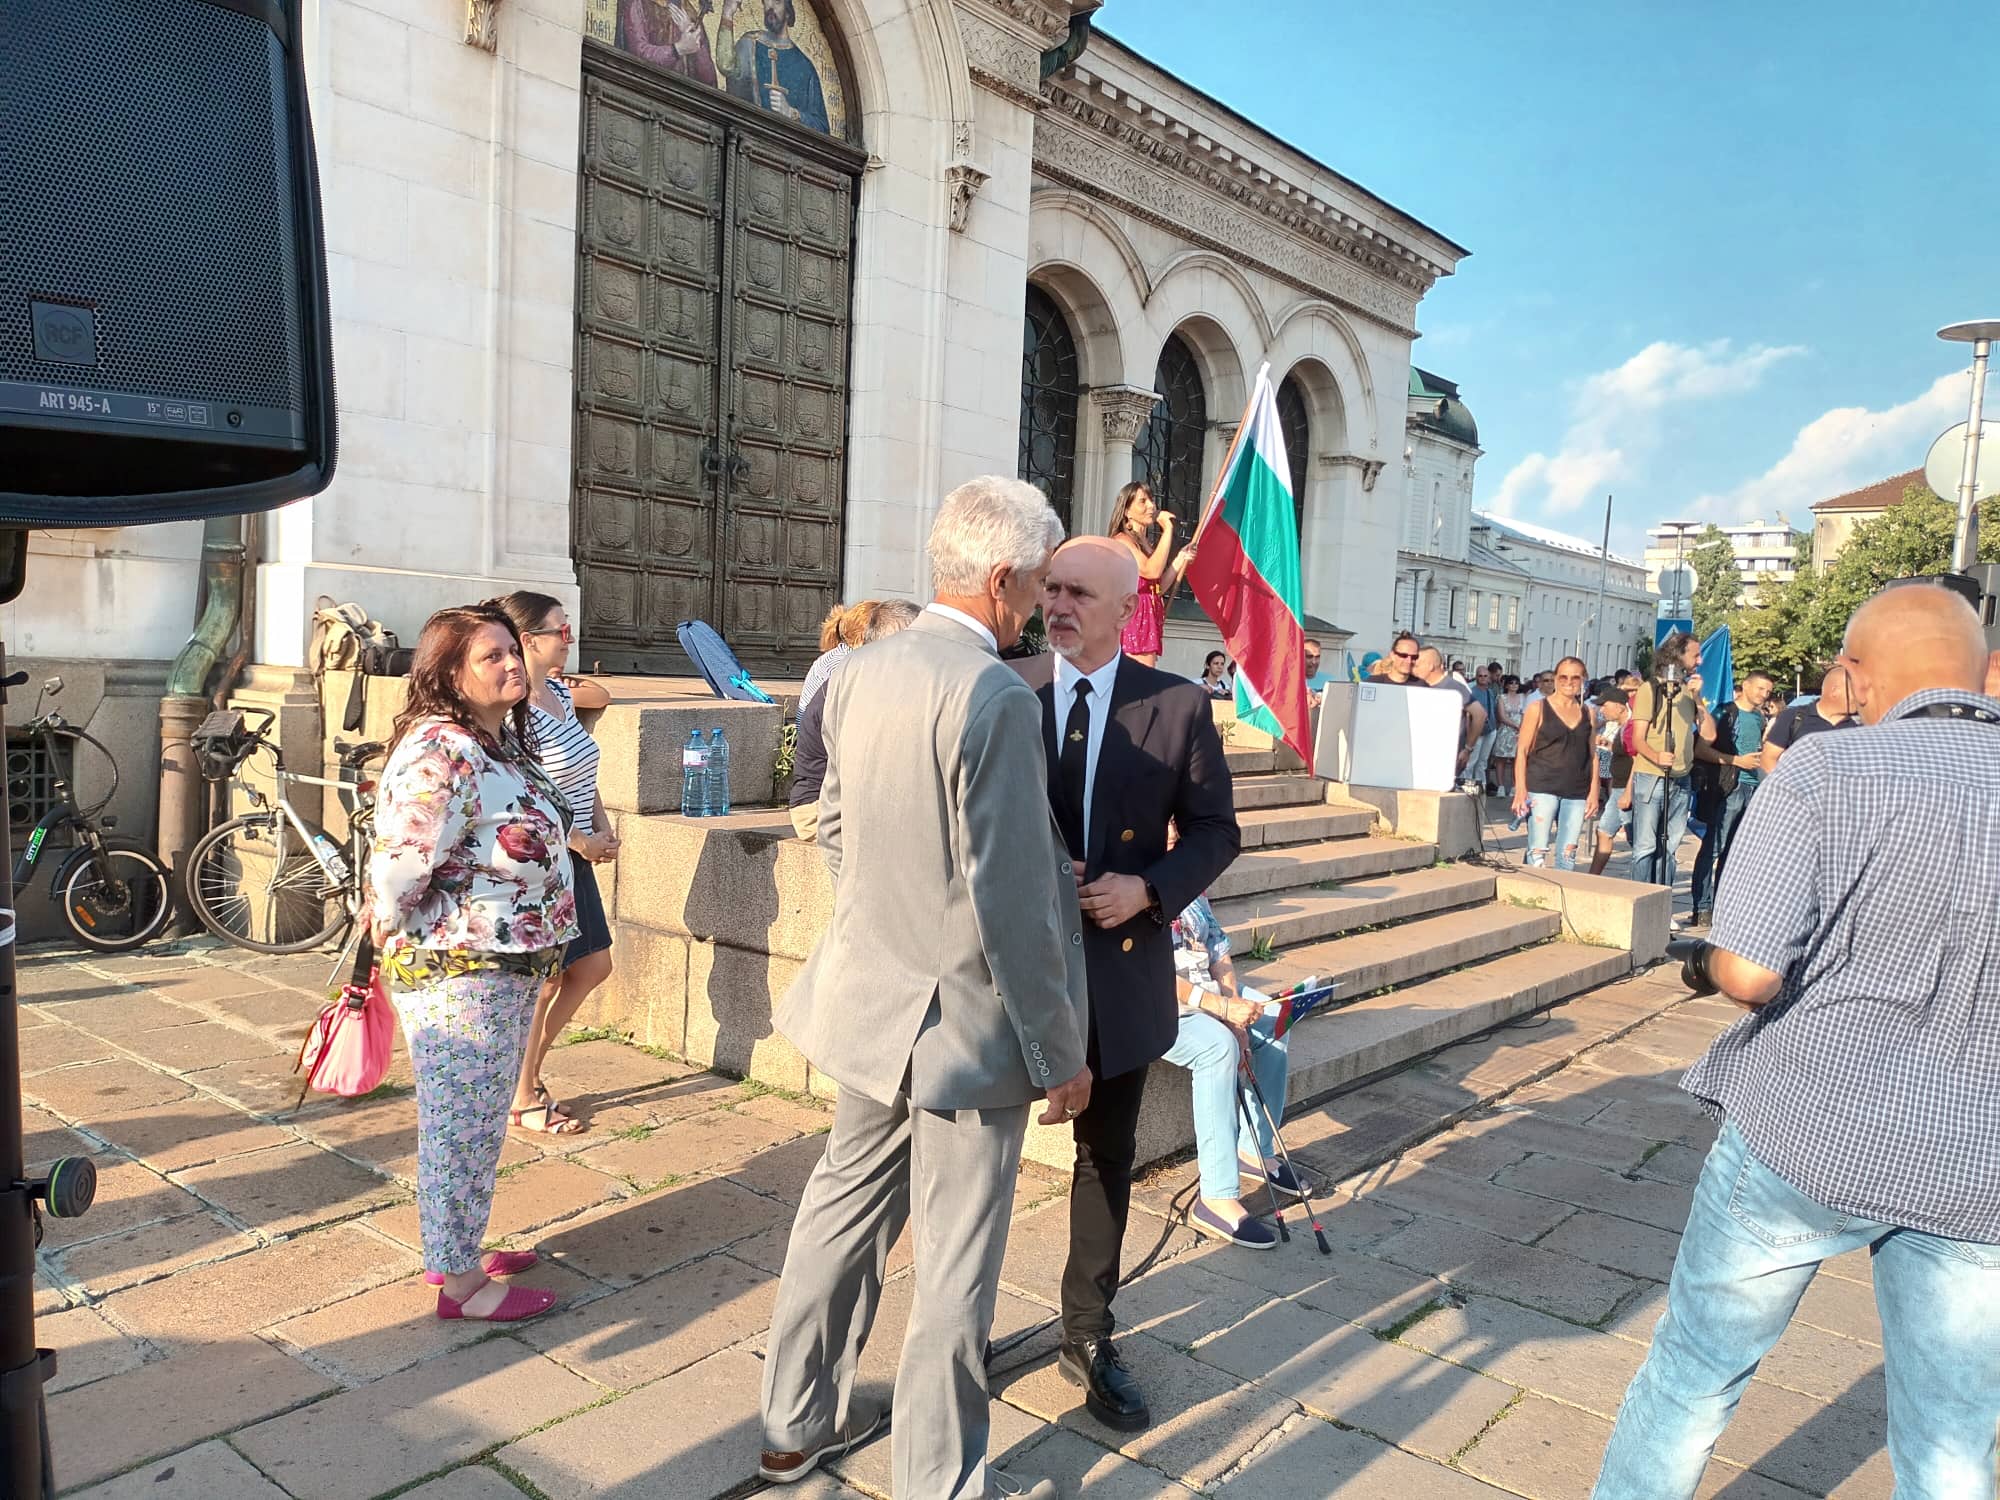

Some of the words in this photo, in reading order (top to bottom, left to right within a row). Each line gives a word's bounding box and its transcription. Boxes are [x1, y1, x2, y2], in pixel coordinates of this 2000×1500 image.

[43, 321, 83, 346] RCF
[39, 391, 65, 409] ART
[68, 394, 111, 414] 945-A
[25, 827, 44, 861] CITYBIKE
